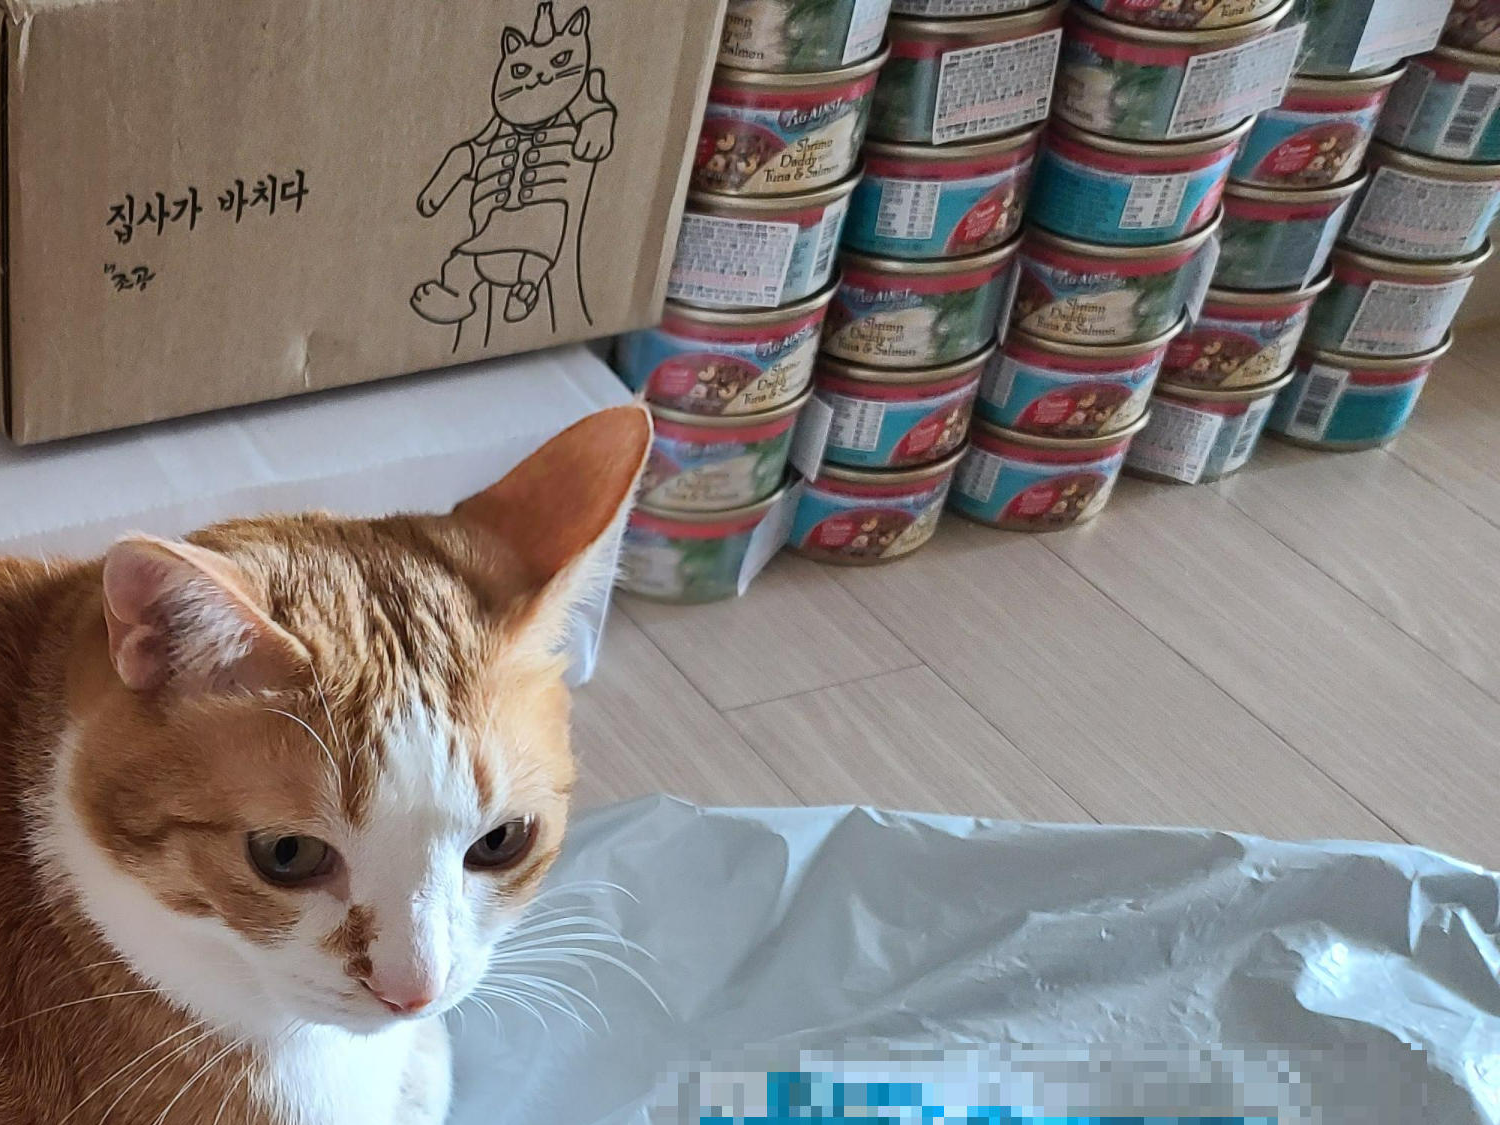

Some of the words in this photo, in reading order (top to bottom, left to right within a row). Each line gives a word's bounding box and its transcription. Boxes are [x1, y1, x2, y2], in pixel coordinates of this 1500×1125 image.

[764, 169, 790, 182] Tuna
[106, 186, 203, 245] 집사가
[218, 169, 309, 224] 바치다
